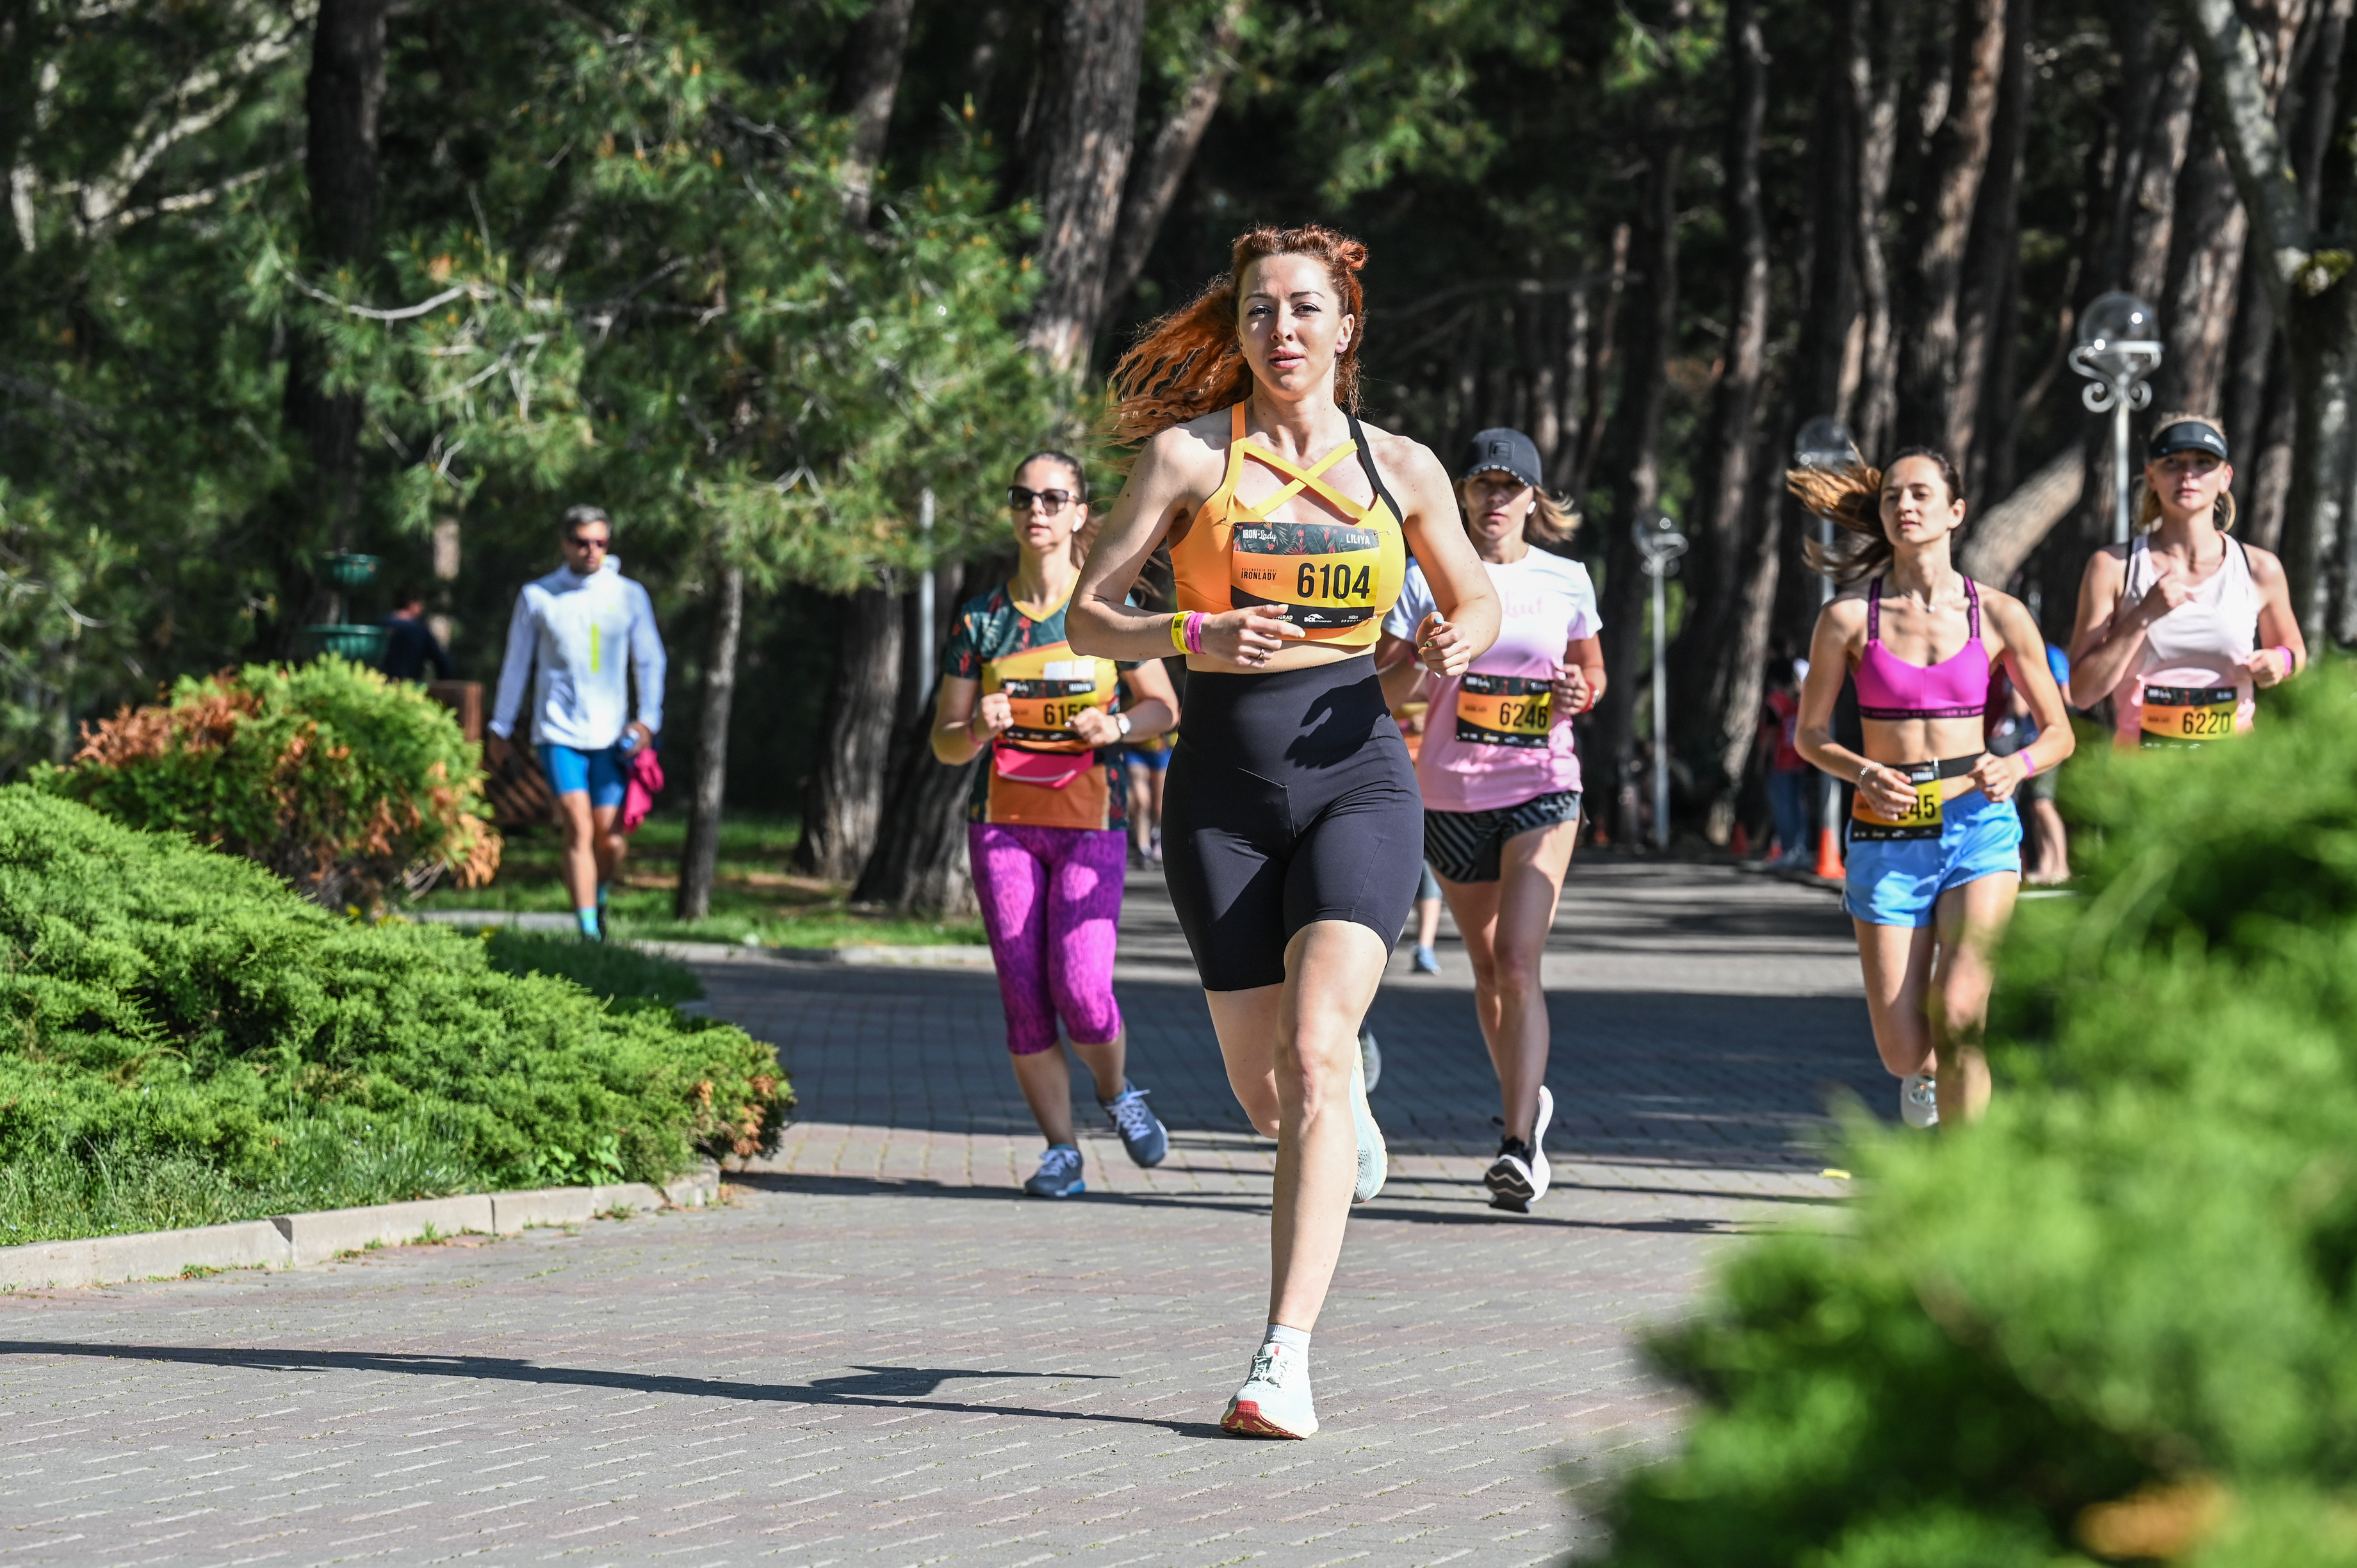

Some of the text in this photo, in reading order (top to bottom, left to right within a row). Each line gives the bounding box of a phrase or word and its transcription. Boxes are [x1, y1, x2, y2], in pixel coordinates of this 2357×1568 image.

[1346, 533, 1371, 545] LILIYA
[1241, 571, 1277, 581] IRONLADY
[1297, 562, 1371, 600] 6104
[1043, 703, 1090, 725] 615
[1499, 702, 1549, 729] 6246
[2183, 712, 2231, 735] 6220
